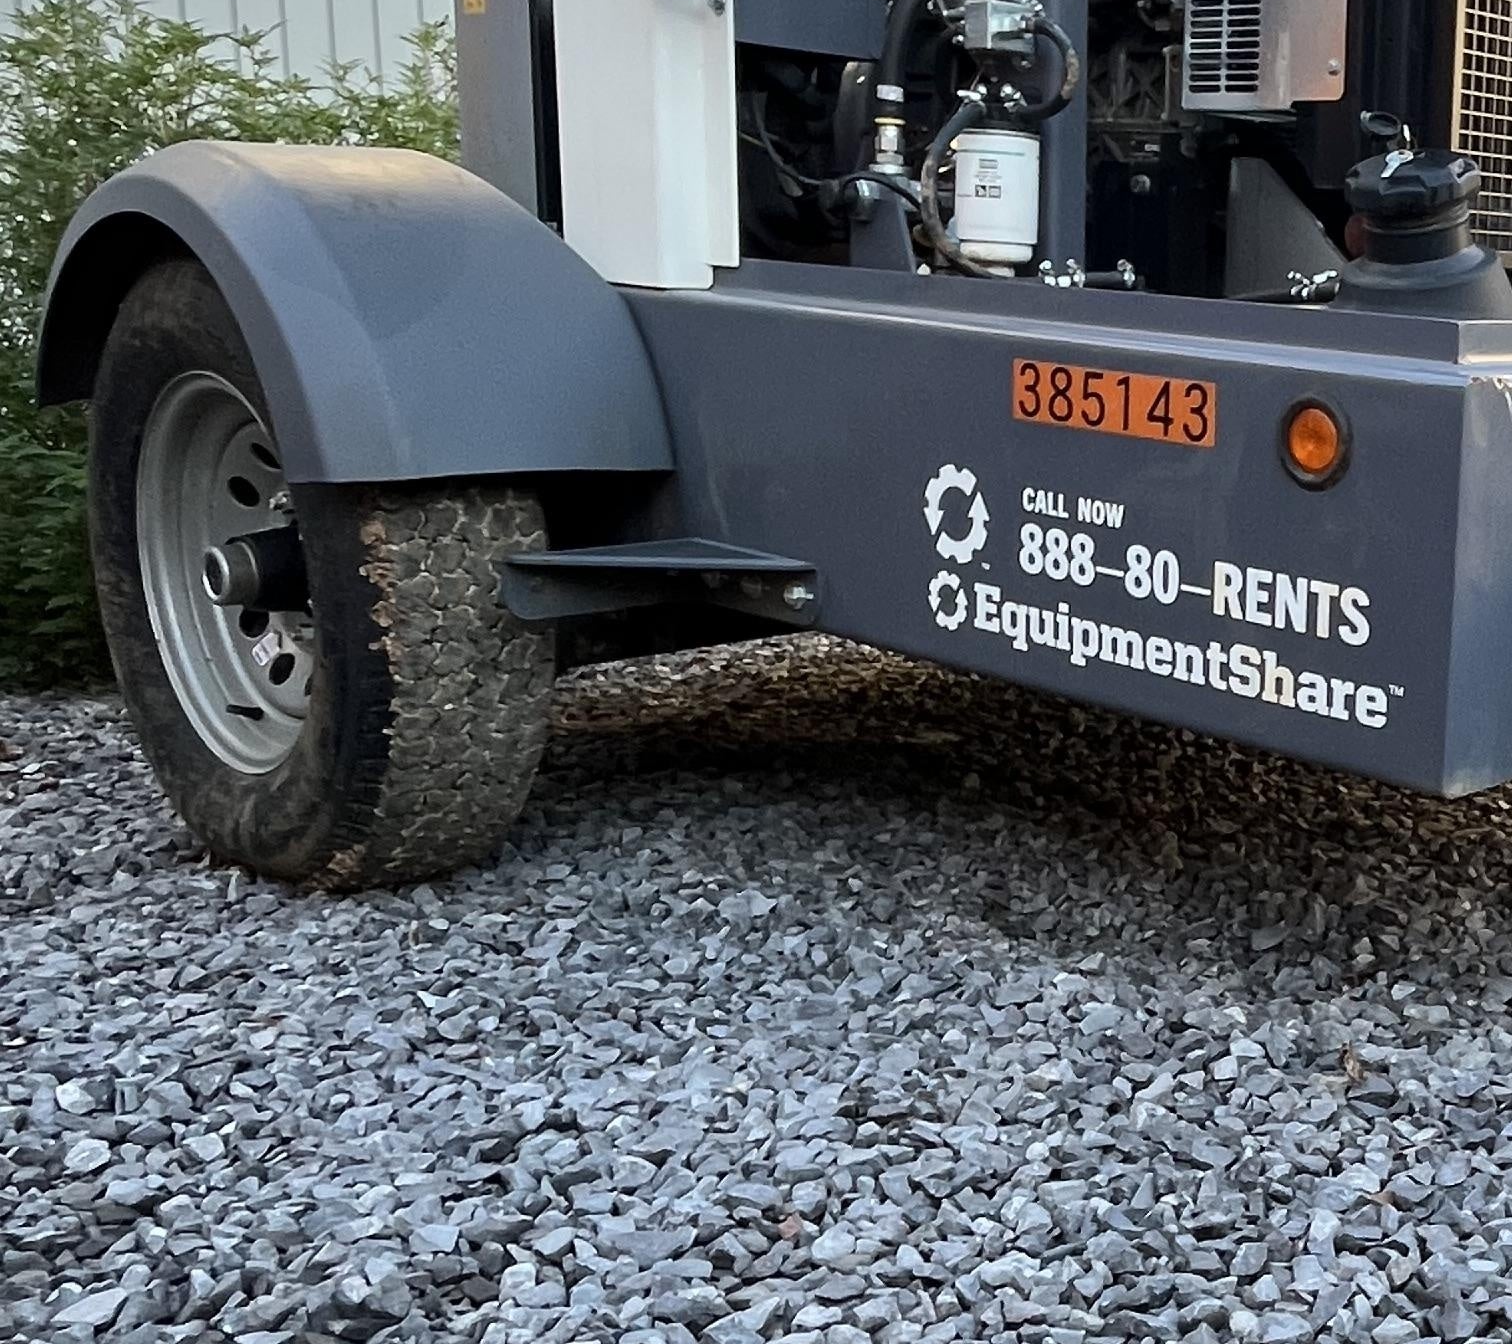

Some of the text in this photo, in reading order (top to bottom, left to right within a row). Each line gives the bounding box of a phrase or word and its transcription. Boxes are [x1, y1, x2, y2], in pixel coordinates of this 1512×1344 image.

[1017, 360, 1211, 444] 385143
[1022, 487, 1124, 529] CALL NOW
